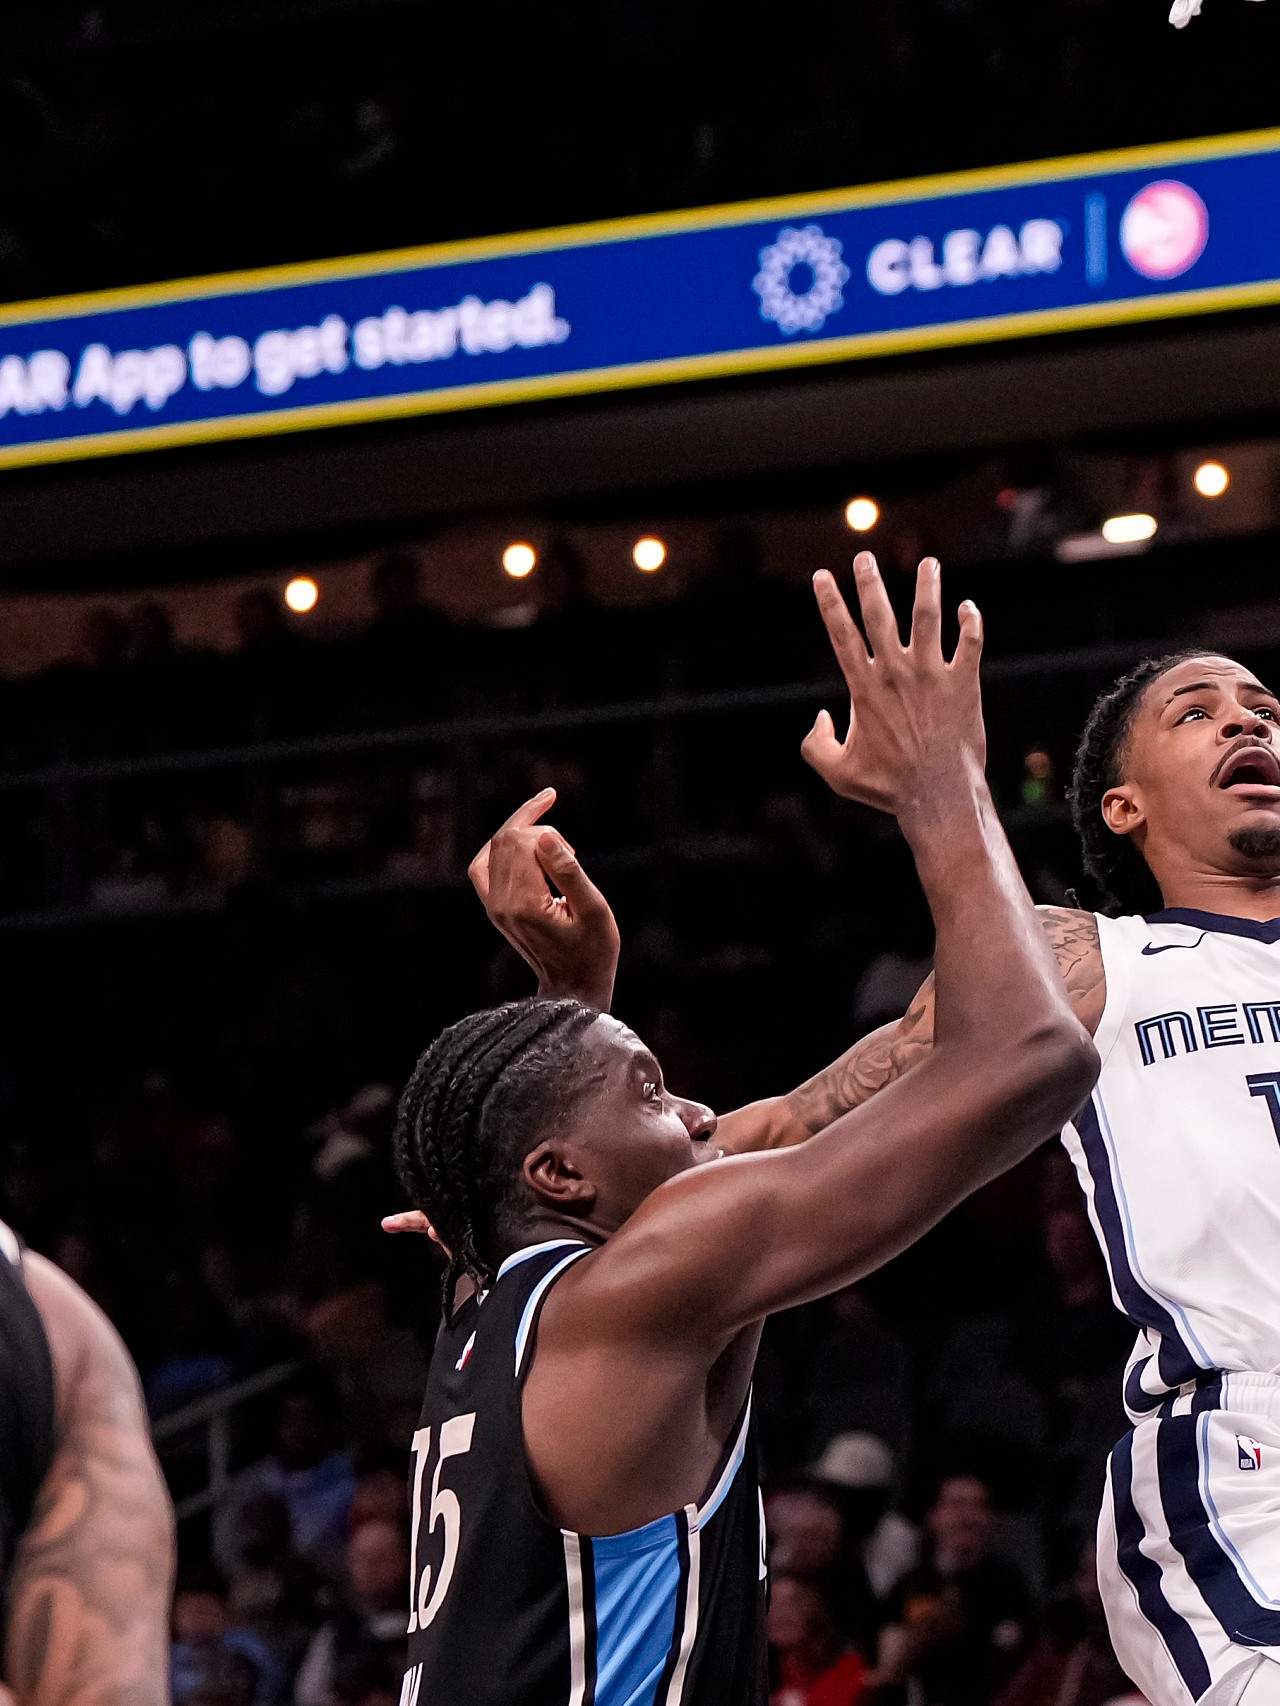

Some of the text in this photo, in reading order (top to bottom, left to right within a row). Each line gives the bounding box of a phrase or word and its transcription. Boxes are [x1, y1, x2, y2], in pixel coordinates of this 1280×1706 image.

[867, 219, 1063, 295] CLEAR
[73, 344, 187, 414] App
[189, 331, 250, 391] to
[253, 315, 348, 395] get
[353, 282, 571, 369] started.
[407, 1411, 477, 1634] 15
